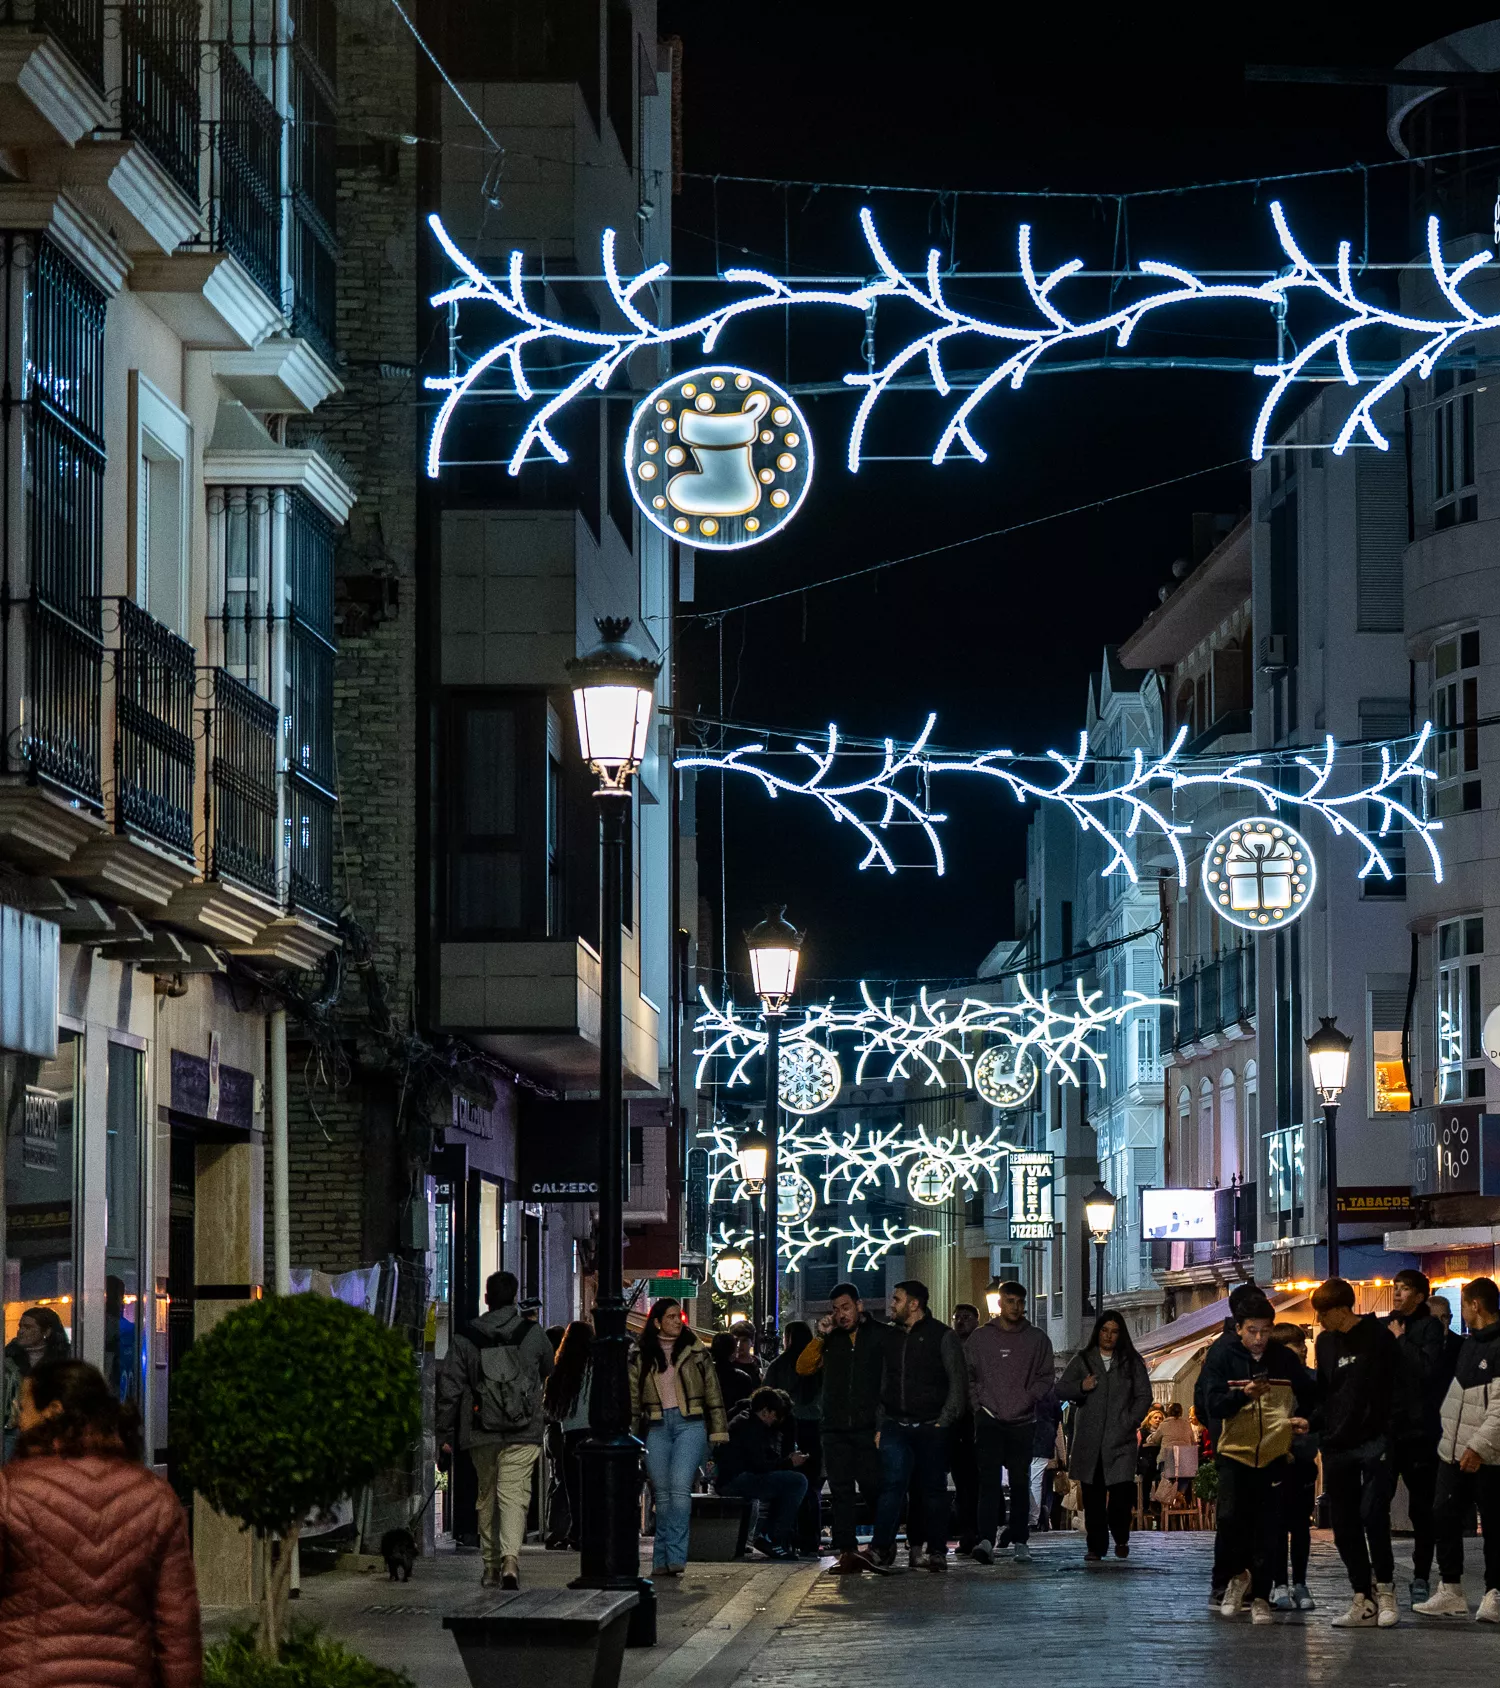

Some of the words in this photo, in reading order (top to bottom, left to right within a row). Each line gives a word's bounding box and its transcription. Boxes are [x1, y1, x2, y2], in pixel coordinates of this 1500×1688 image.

[1009, 1152, 1054, 1165] RESTAURANTE
[1026, 1165, 1052, 1177] VIA
[1349, 1196, 1410, 1207] TABACOS
[1010, 1222, 1054, 1239] PIZZERÍA
